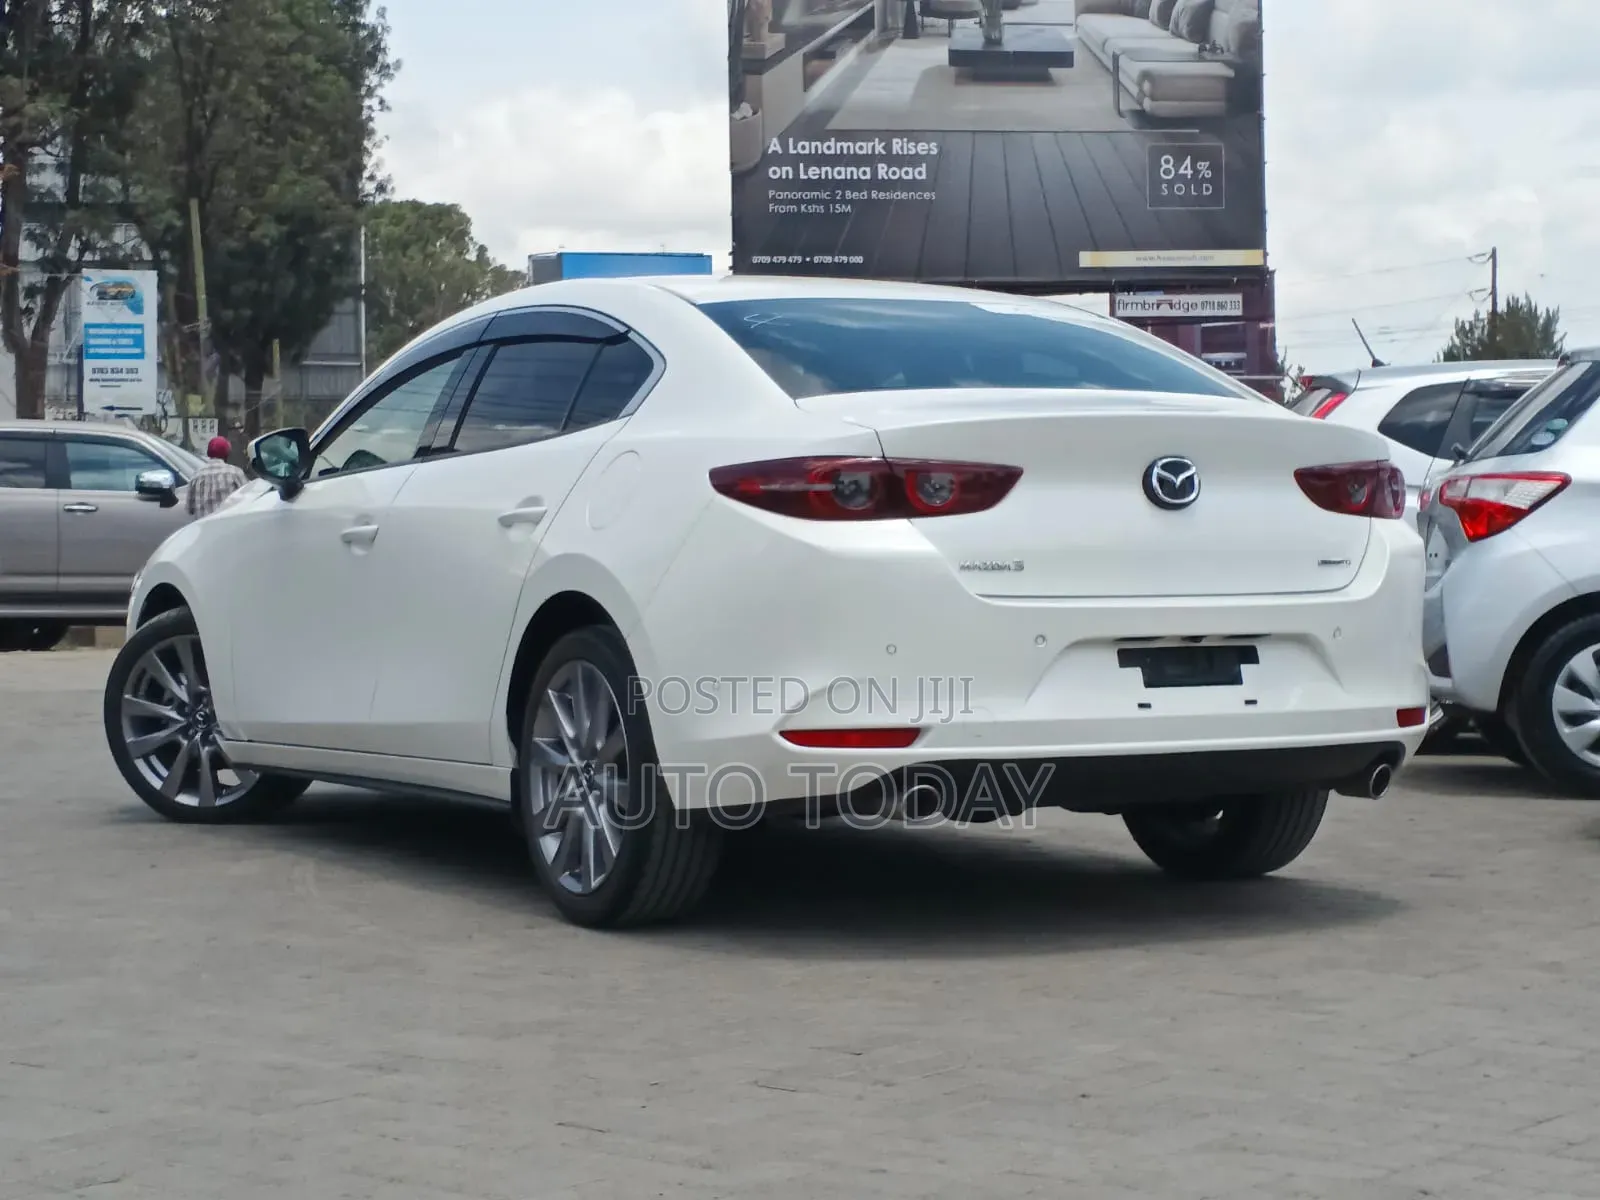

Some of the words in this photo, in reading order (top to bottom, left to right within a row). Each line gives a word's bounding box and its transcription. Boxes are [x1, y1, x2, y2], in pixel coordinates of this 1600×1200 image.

[767, 137, 783, 155] A
[788, 137, 887, 155] Landmark
[892, 137, 938, 155] Rises
[768, 165, 793, 180] on
[799, 163, 871, 180] Lenana
[877, 163, 927, 180] Road
[1160, 154, 1212, 179] 84%
[768, 189, 831, 200] Panoramic
[835, 190, 842, 200] 2
[845, 189, 868, 200] Bed
[871, 189, 936, 201] Residences
[1161, 183, 1212, 196] SOLD
[768, 203, 798, 213] From
[800, 203, 825, 213] Kshs
[829, 203, 851, 213] 15M
[752, 255, 771, 264] 0709
[772, 255, 786, 264] 479
[787, 255, 802, 264] 479
